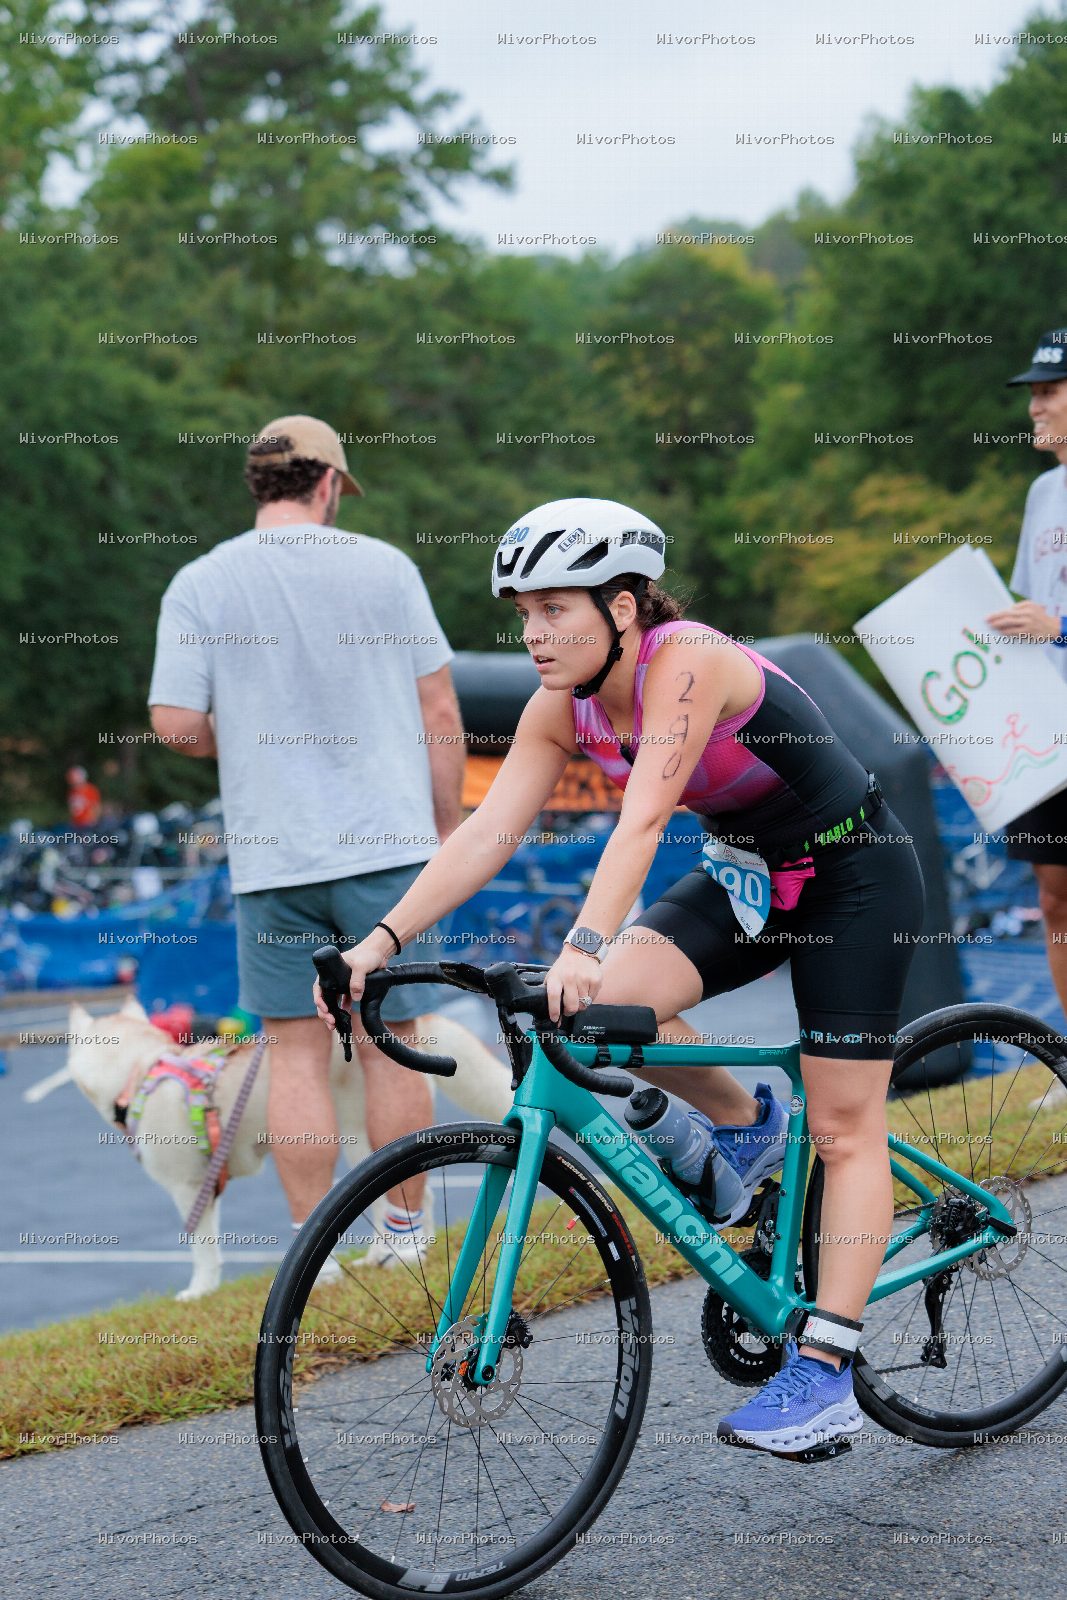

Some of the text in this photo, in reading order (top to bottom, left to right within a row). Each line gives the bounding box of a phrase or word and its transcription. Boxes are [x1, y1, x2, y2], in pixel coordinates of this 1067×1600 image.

[920, 627, 1002, 726] GO!
[758, 1048, 790, 1057] SPRINT
[580, 1112, 748, 1286] Bianchi
